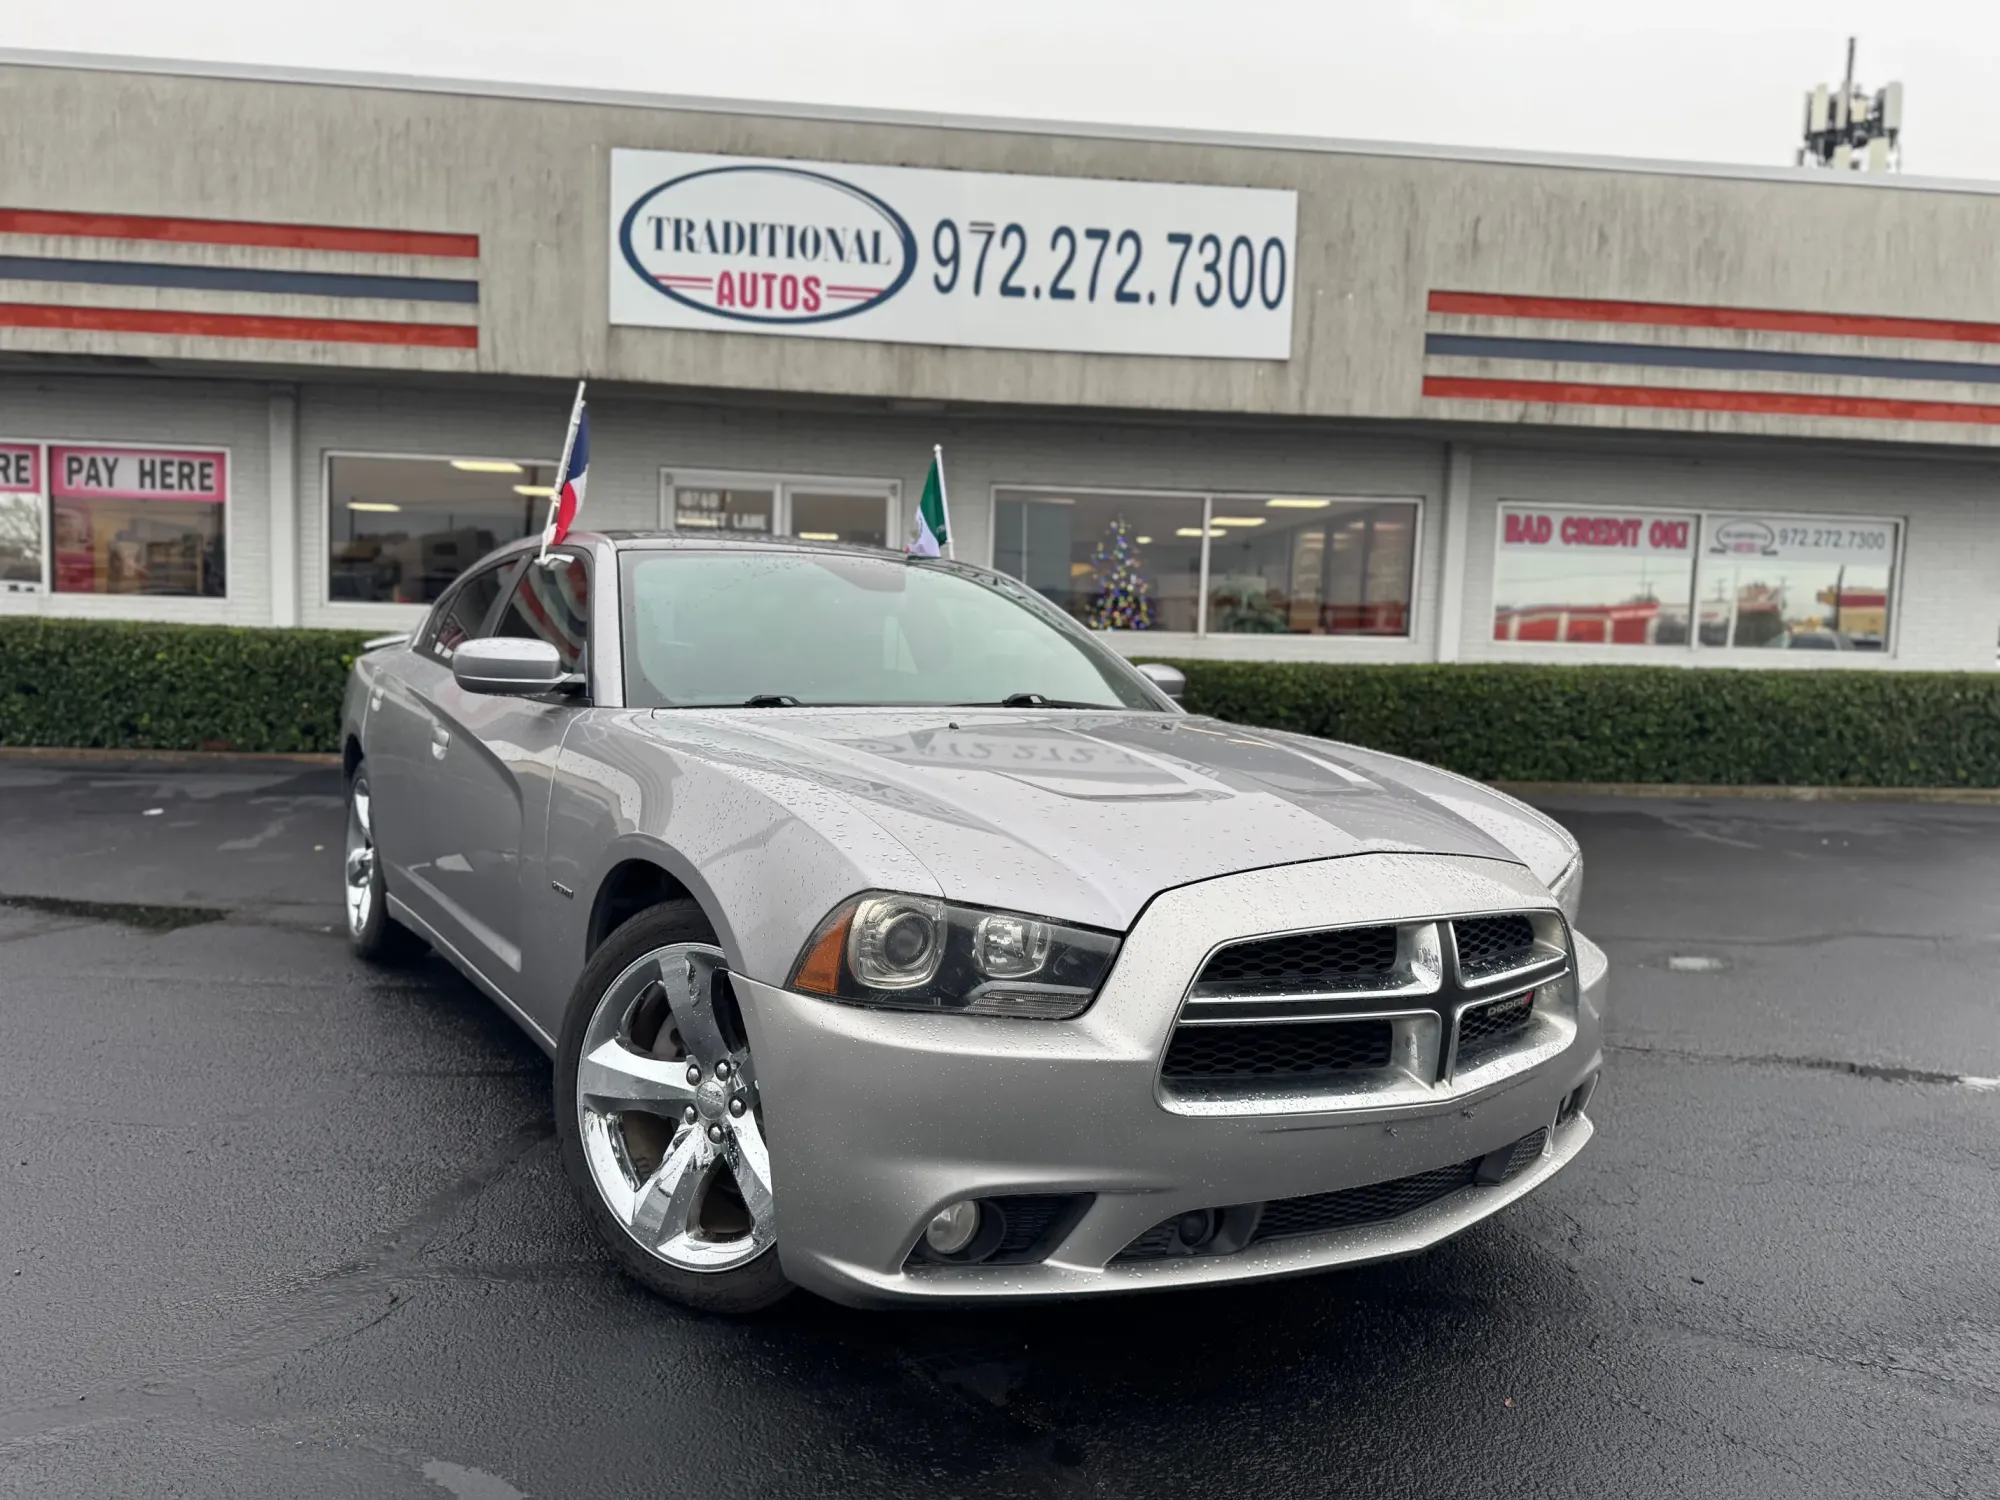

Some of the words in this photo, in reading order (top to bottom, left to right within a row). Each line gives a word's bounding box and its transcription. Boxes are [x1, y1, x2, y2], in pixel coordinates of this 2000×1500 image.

[647, 215, 892, 266] TRADITIONAL
[932, 218, 1287, 311] 972.272.7300
[716, 269, 822, 313] AUTOS
[66, 455, 119, 488] PAY
[138, 458, 215, 492] HERE
[1504, 513, 1553, 545] BAD
[1560, 515, 1643, 548] CREDIT
[1778, 527, 1887, 551] 972.272.7300
